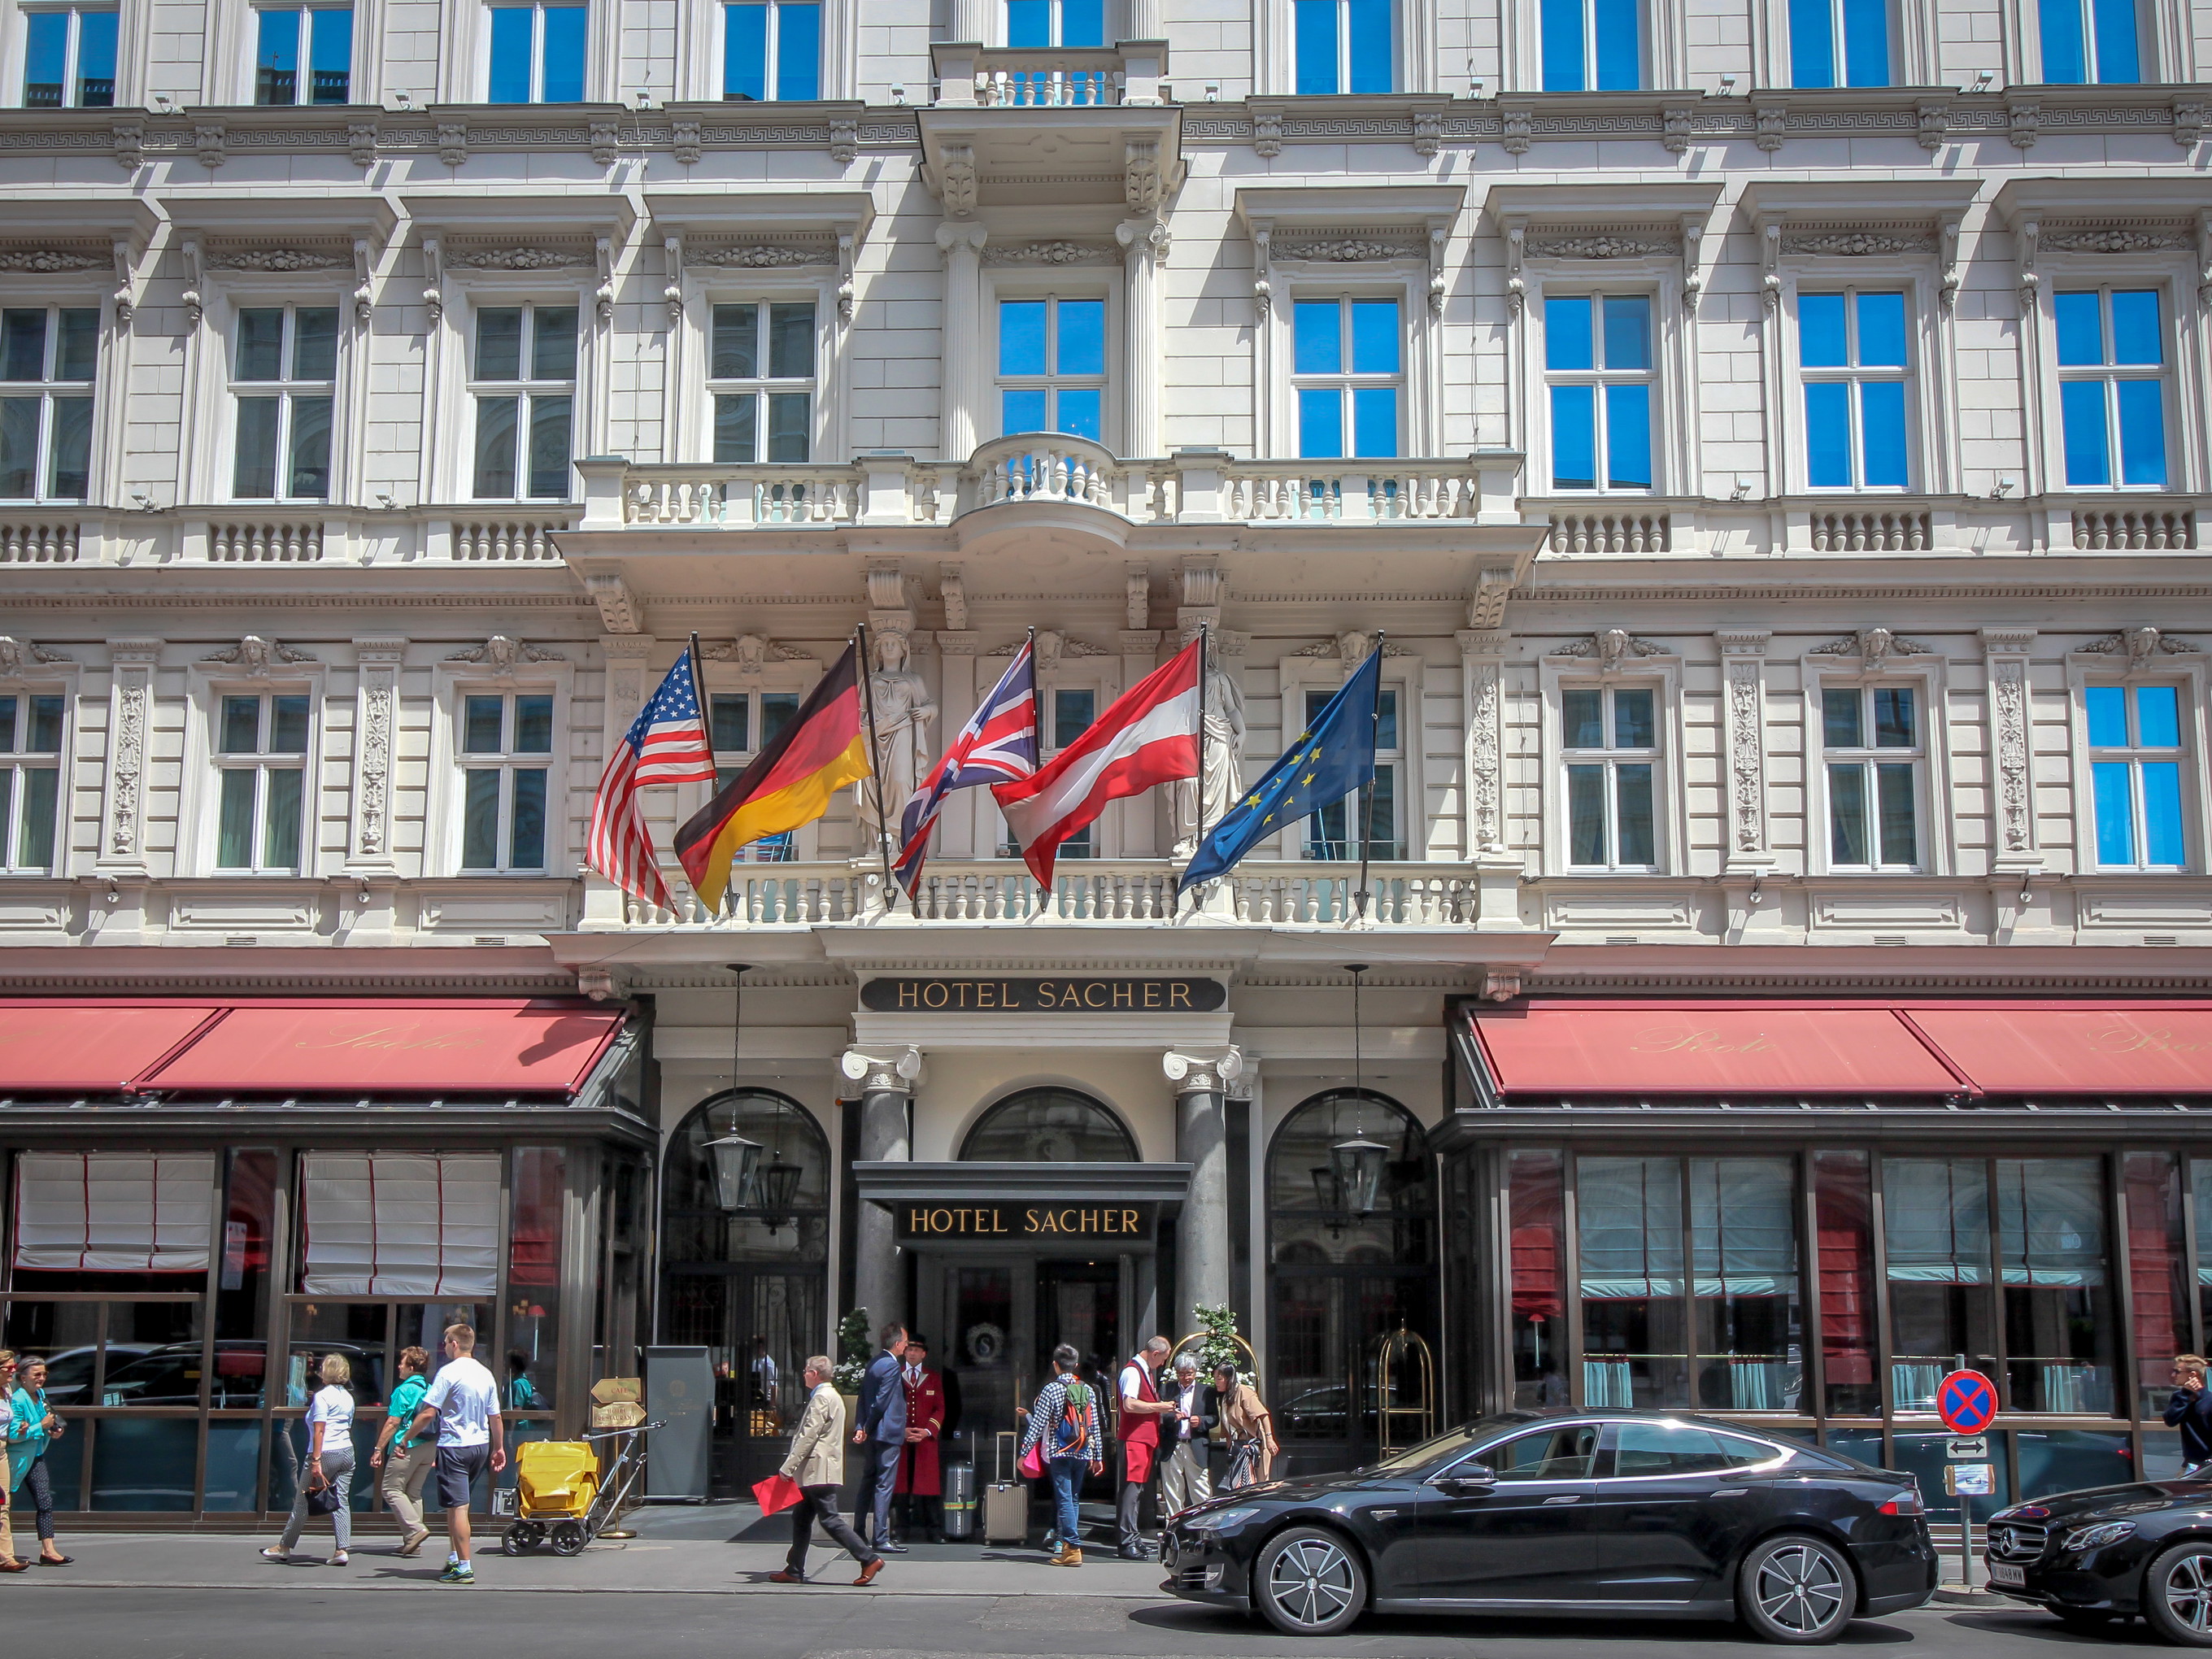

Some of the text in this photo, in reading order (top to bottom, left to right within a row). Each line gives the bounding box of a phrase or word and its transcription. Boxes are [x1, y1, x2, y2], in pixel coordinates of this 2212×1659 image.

[898, 982, 1193, 1008] HOTEL SACHER
[295, 1022, 486, 1049] Sacher
[2086, 1023, 2212, 1053] Ba
[911, 1208, 1139, 1233] HOTEL SACHER
[597, 1414, 636, 1422] RESTAURANT
